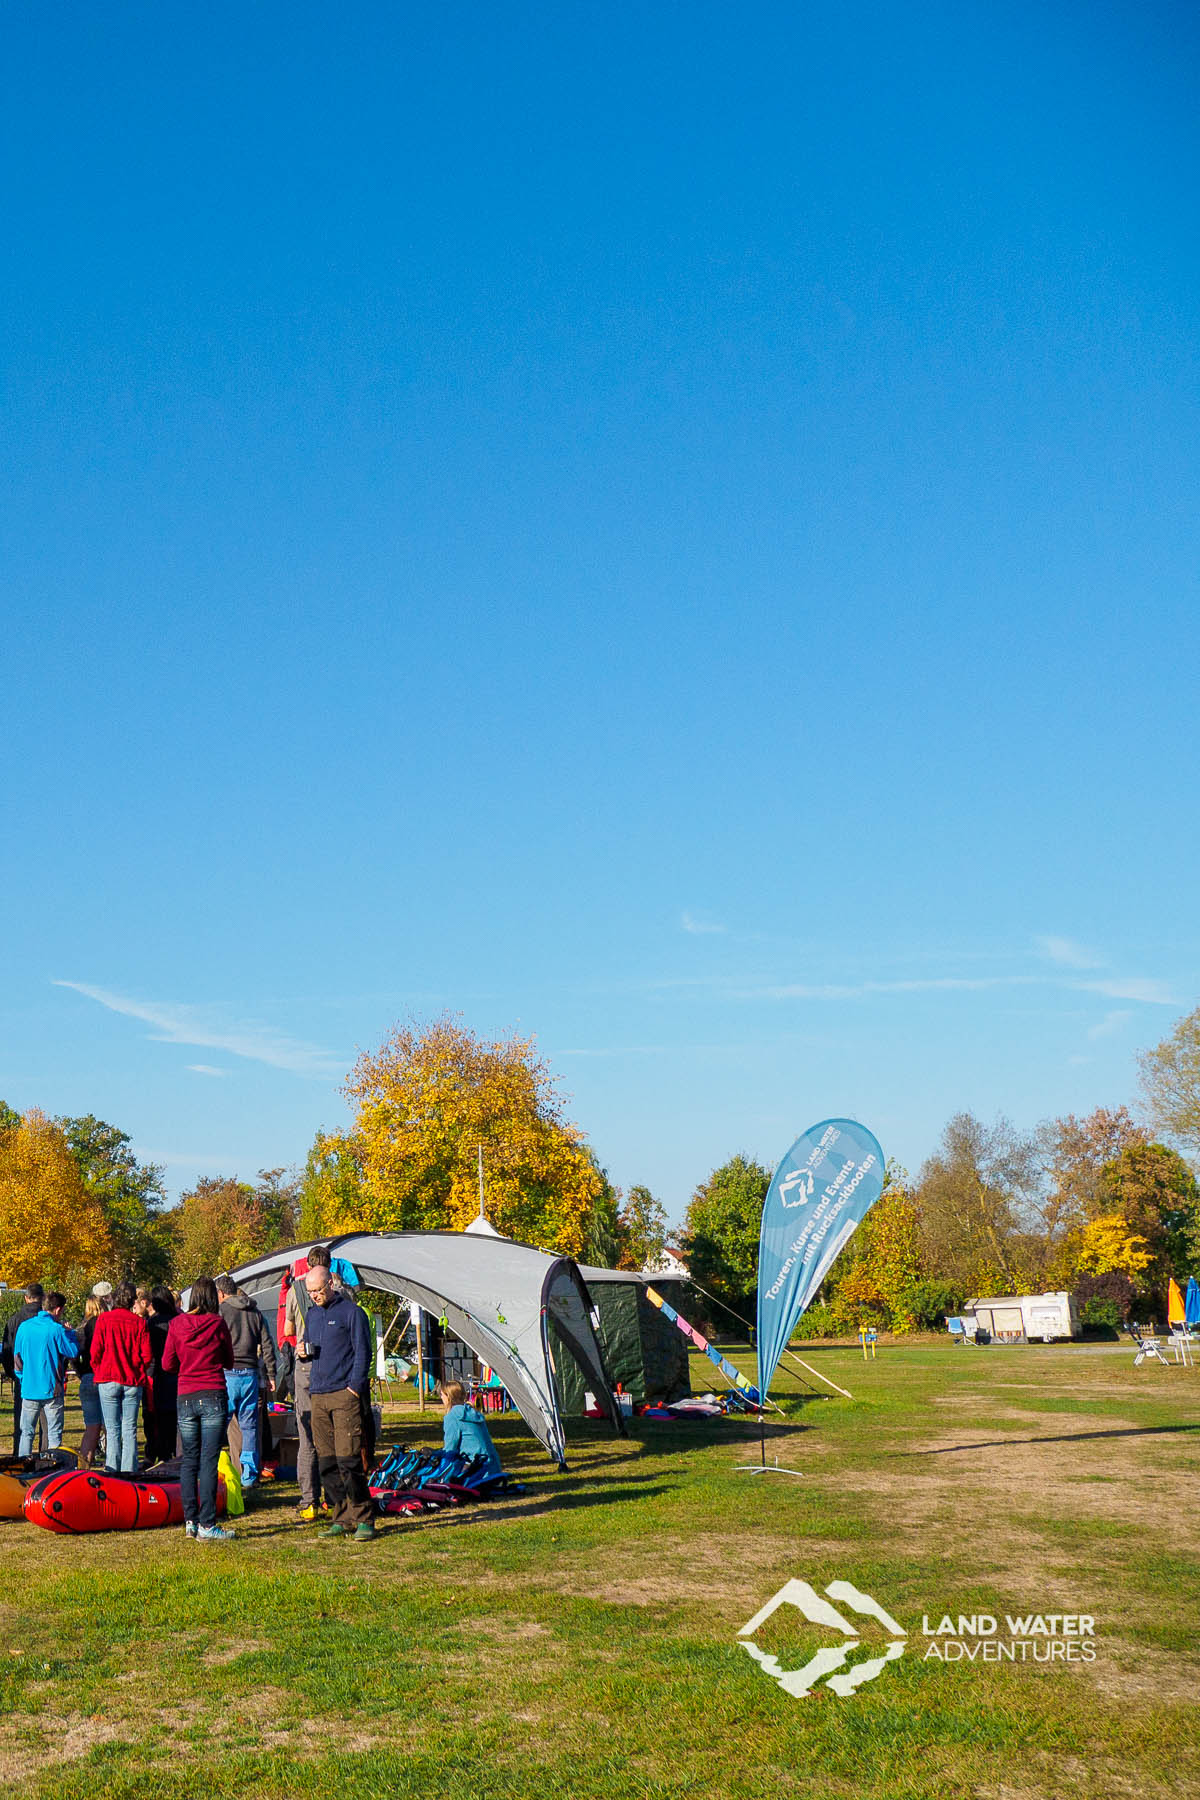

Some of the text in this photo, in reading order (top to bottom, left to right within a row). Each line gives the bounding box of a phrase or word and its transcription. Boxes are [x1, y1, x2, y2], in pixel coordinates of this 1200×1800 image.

[765, 1256, 796, 1300] Touren,
[790, 1221, 815, 1254] Kurse
[812, 1194, 831, 1220] und
[825, 1159, 855, 1196] Events
[802, 1242, 817, 1265] mit
[811, 1153, 876, 1244] Rucksackbooten
